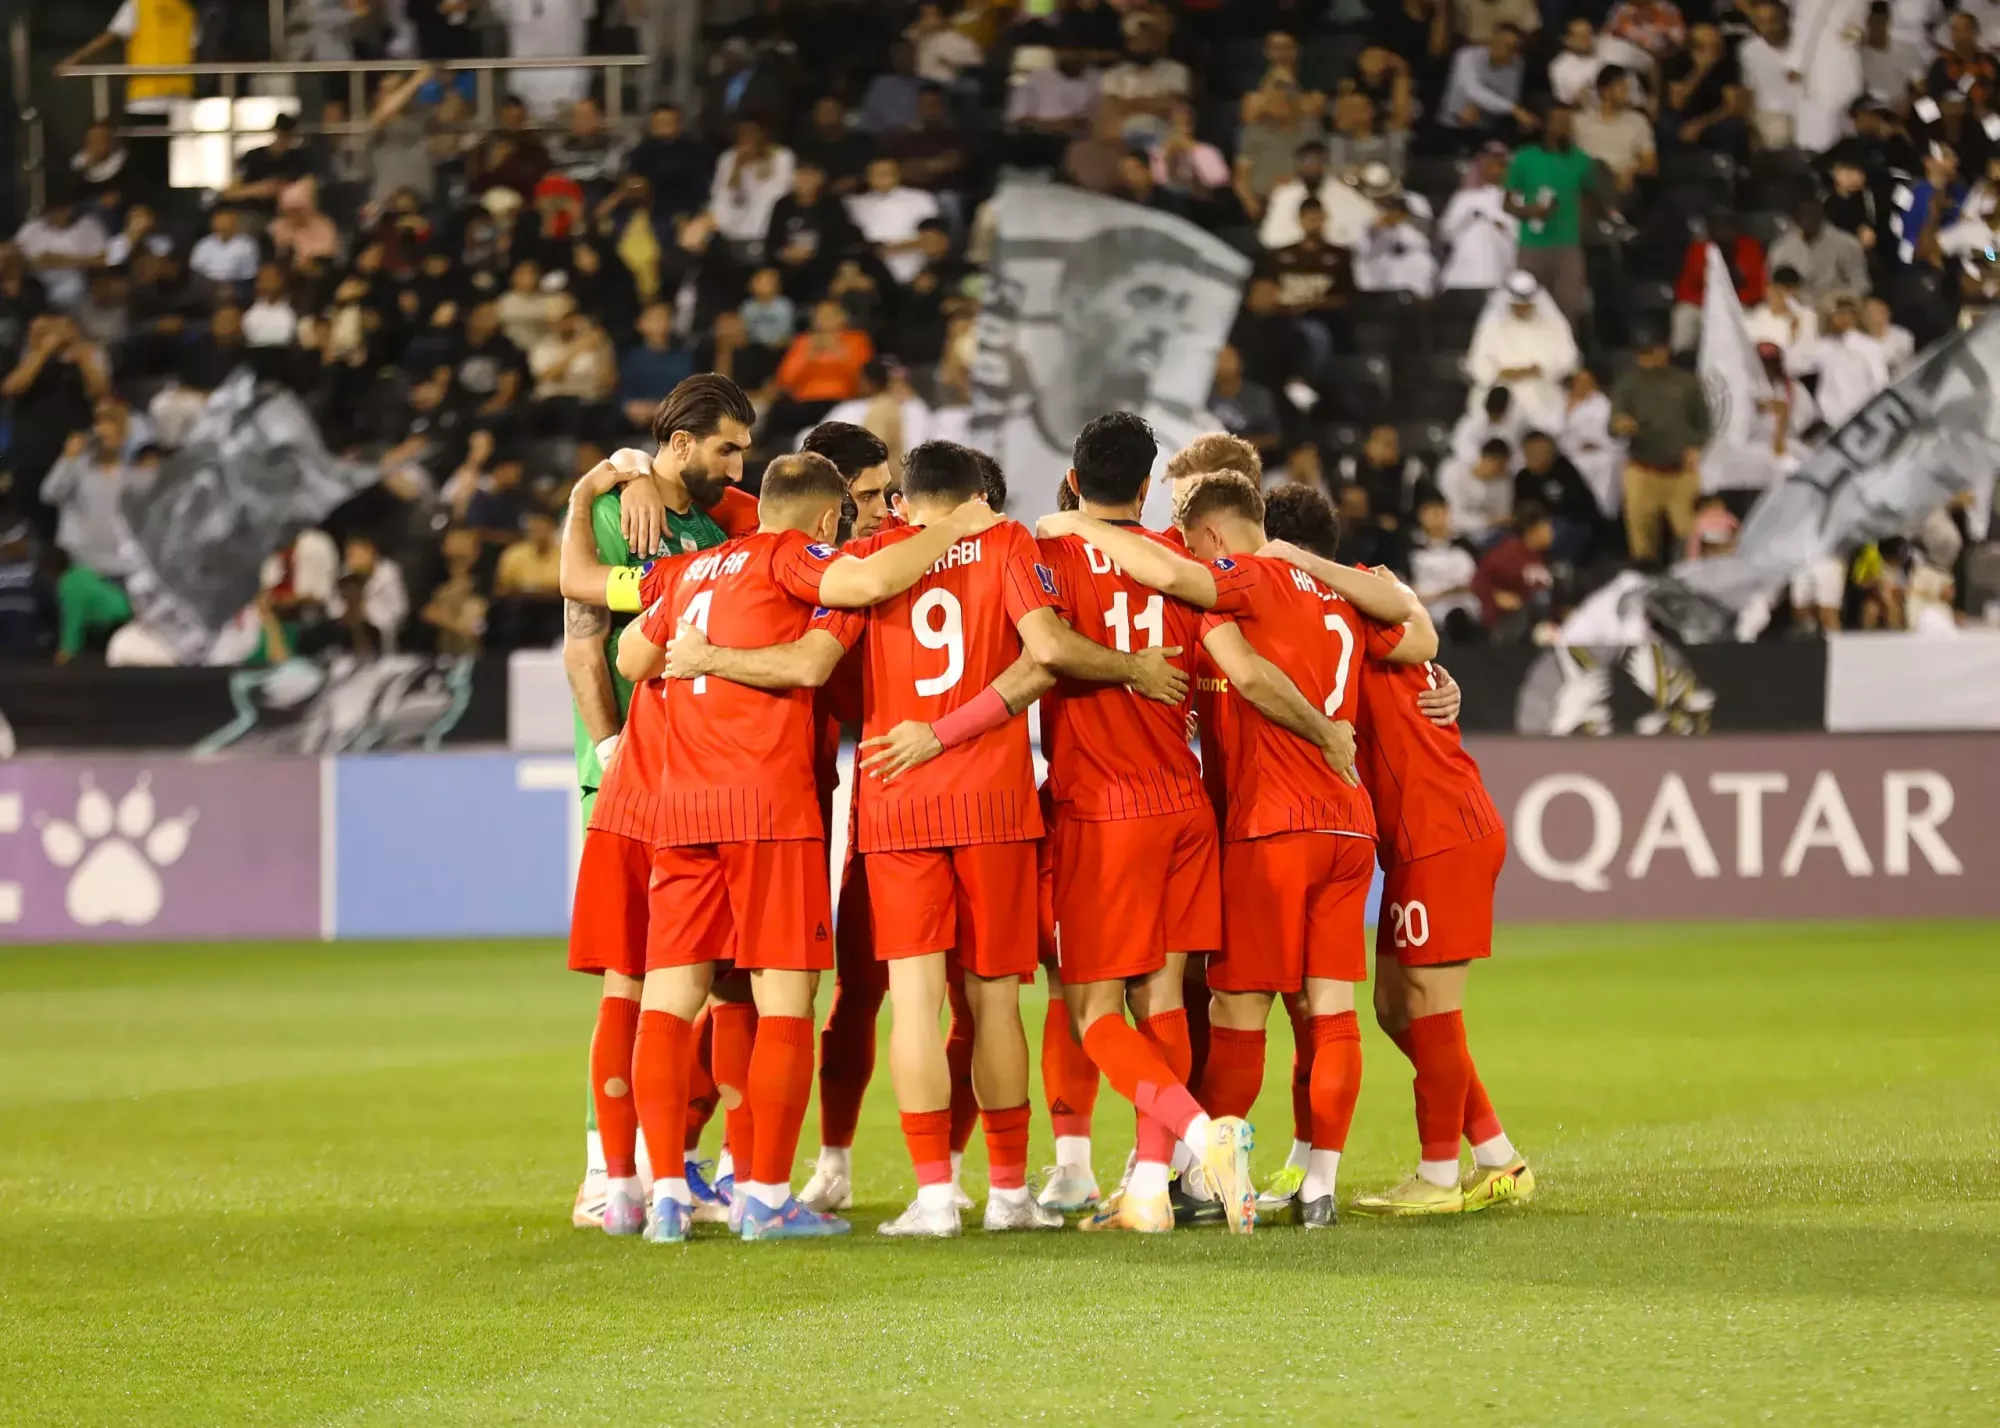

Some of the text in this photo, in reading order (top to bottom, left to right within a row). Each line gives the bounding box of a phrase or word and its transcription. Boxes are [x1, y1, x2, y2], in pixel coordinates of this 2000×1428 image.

[911, 587, 964, 697] 9
[1104, 591, 1164, 692] 11
[1512, 770, 1964, 892] QATAR
[1390, 900, 1429, 948] 20
